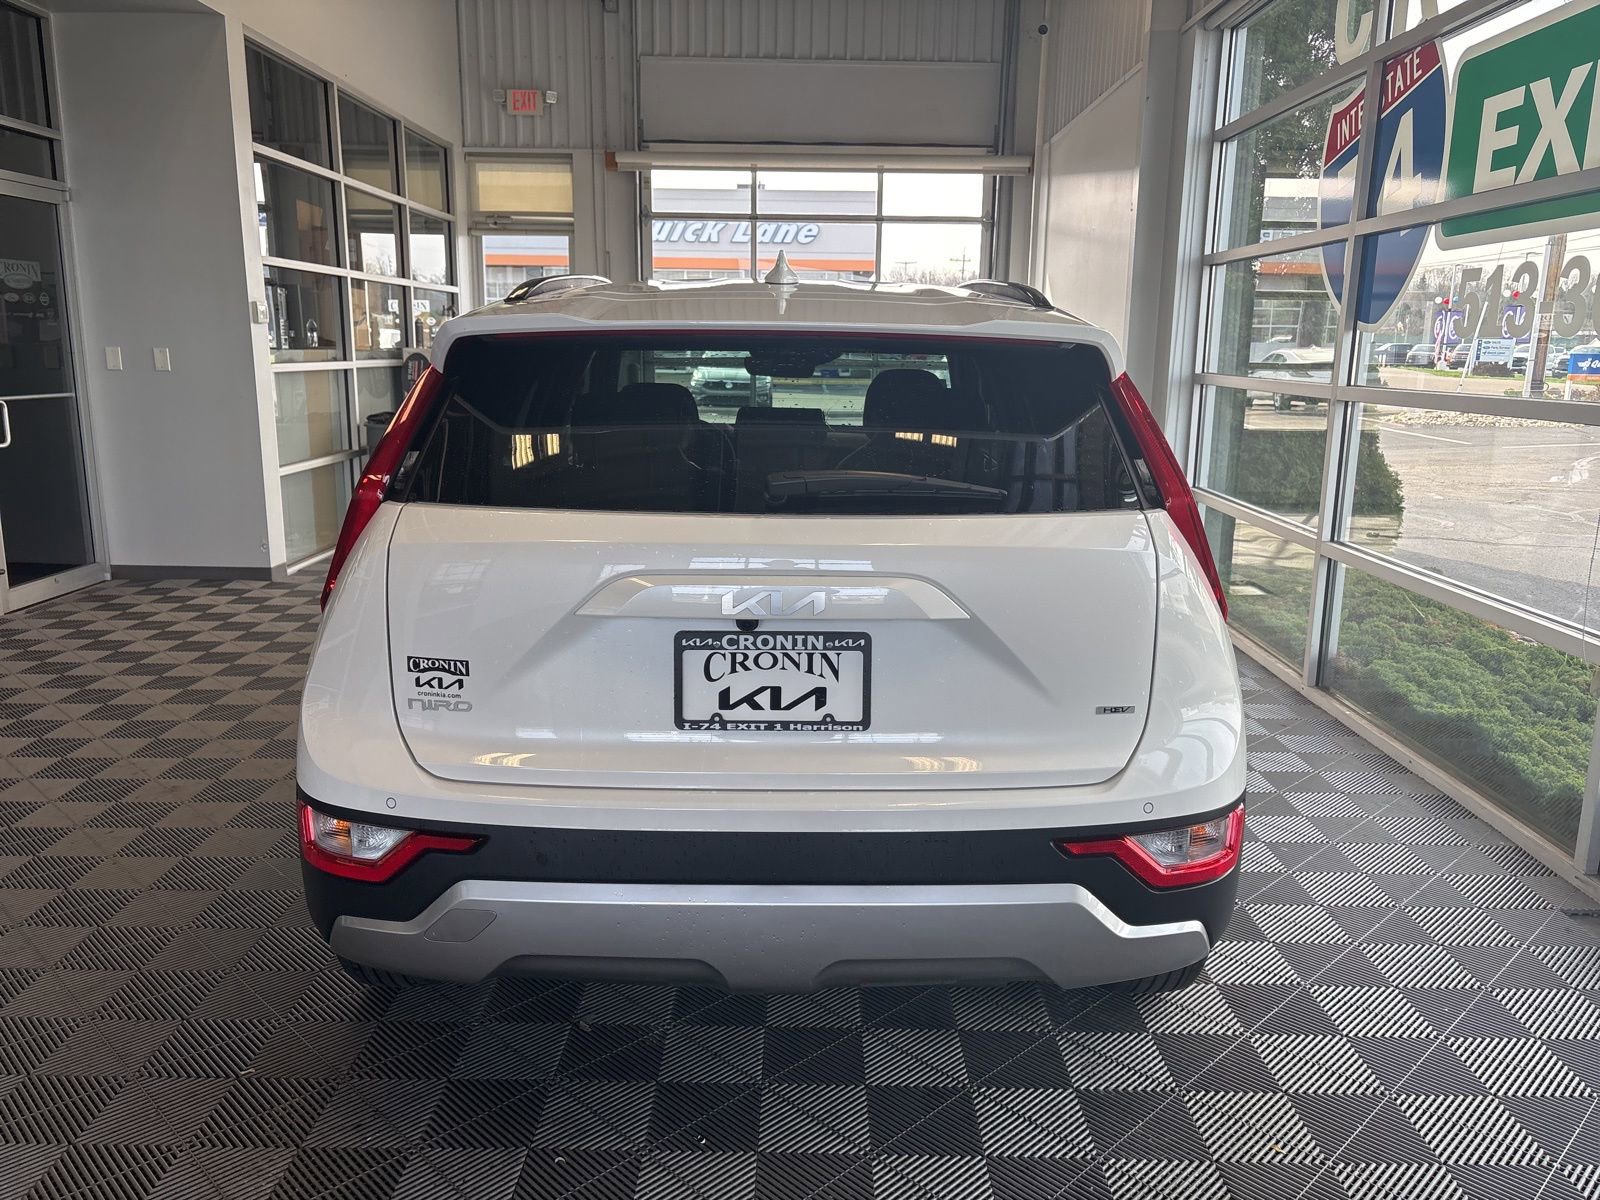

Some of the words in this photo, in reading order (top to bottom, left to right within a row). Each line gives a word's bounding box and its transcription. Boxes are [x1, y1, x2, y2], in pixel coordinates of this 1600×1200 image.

[511, 90, 537, 112] EXIT
[1337, 46, 1423, 150] INTETATE
[0, 260, 39, 280] RONIN
[1453, 255, 1600, 339] 513-3
[721, 590, 826, 616] KIA
[682, 638, 713, 647] KIA
[721, 635, 824, 650] CRONIN
[834, 638, 865, 647] KIA
[409, 657, 467, 676] CRONIN
[703, 651, 842, 683] CRONIN
[415, 675, 464, 690] KIA
[417, 691, 462, 699] croninkia.com
[718, 686, 827, 711] KIA
[683, 723, 721, 731] I-74
[726, 723, 769, 731] EXIT
[774, 723, 783, 731] 1
[789, 723, 863, 731] Harrison
